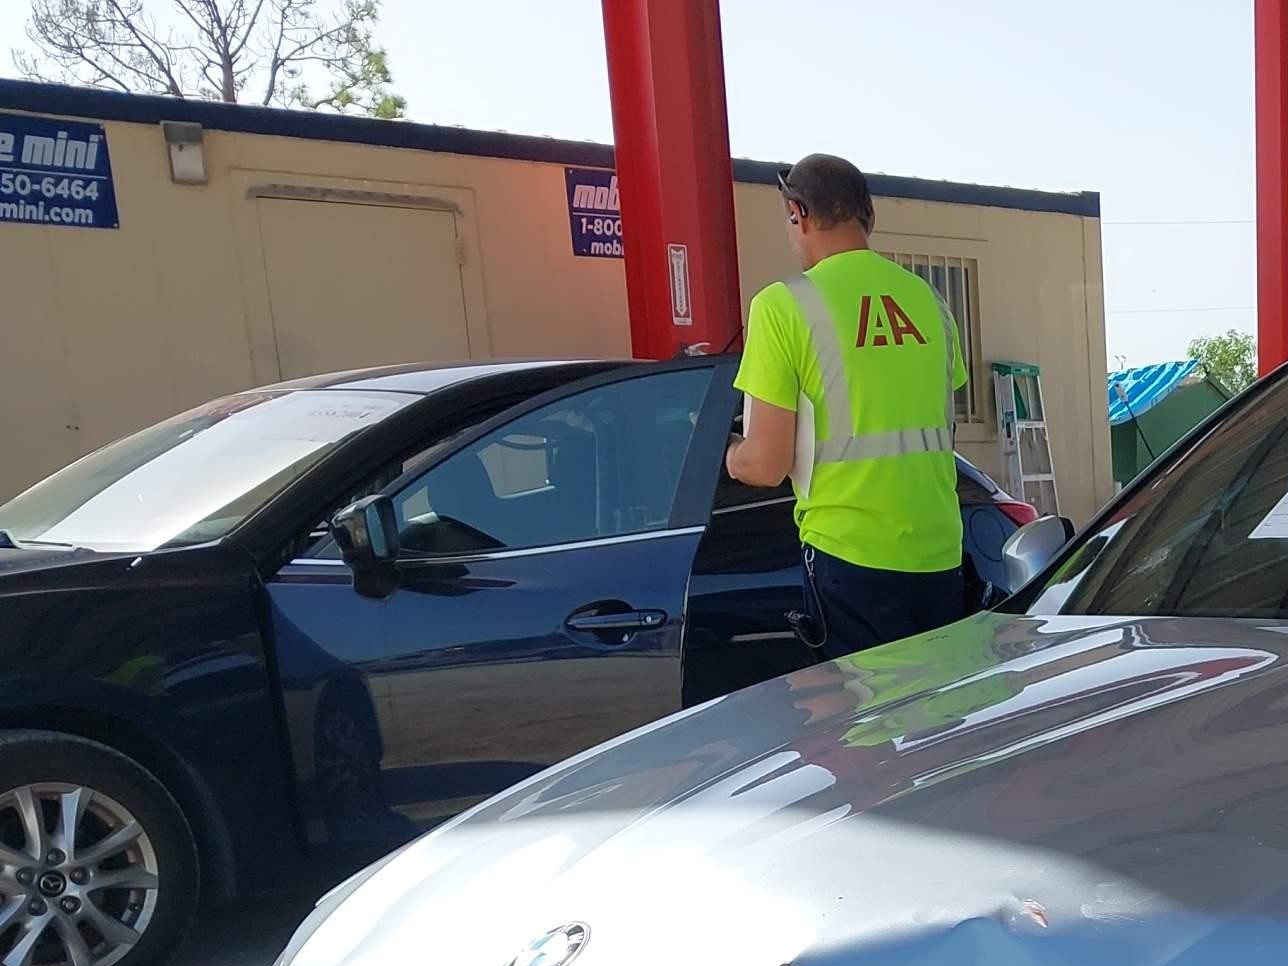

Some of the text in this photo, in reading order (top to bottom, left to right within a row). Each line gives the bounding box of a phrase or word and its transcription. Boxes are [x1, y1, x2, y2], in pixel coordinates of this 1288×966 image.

[21, 131, 100, 170] mini
[0, 173, 99, 200] 50-6464
[0, 199, 94, 224] mini.com
